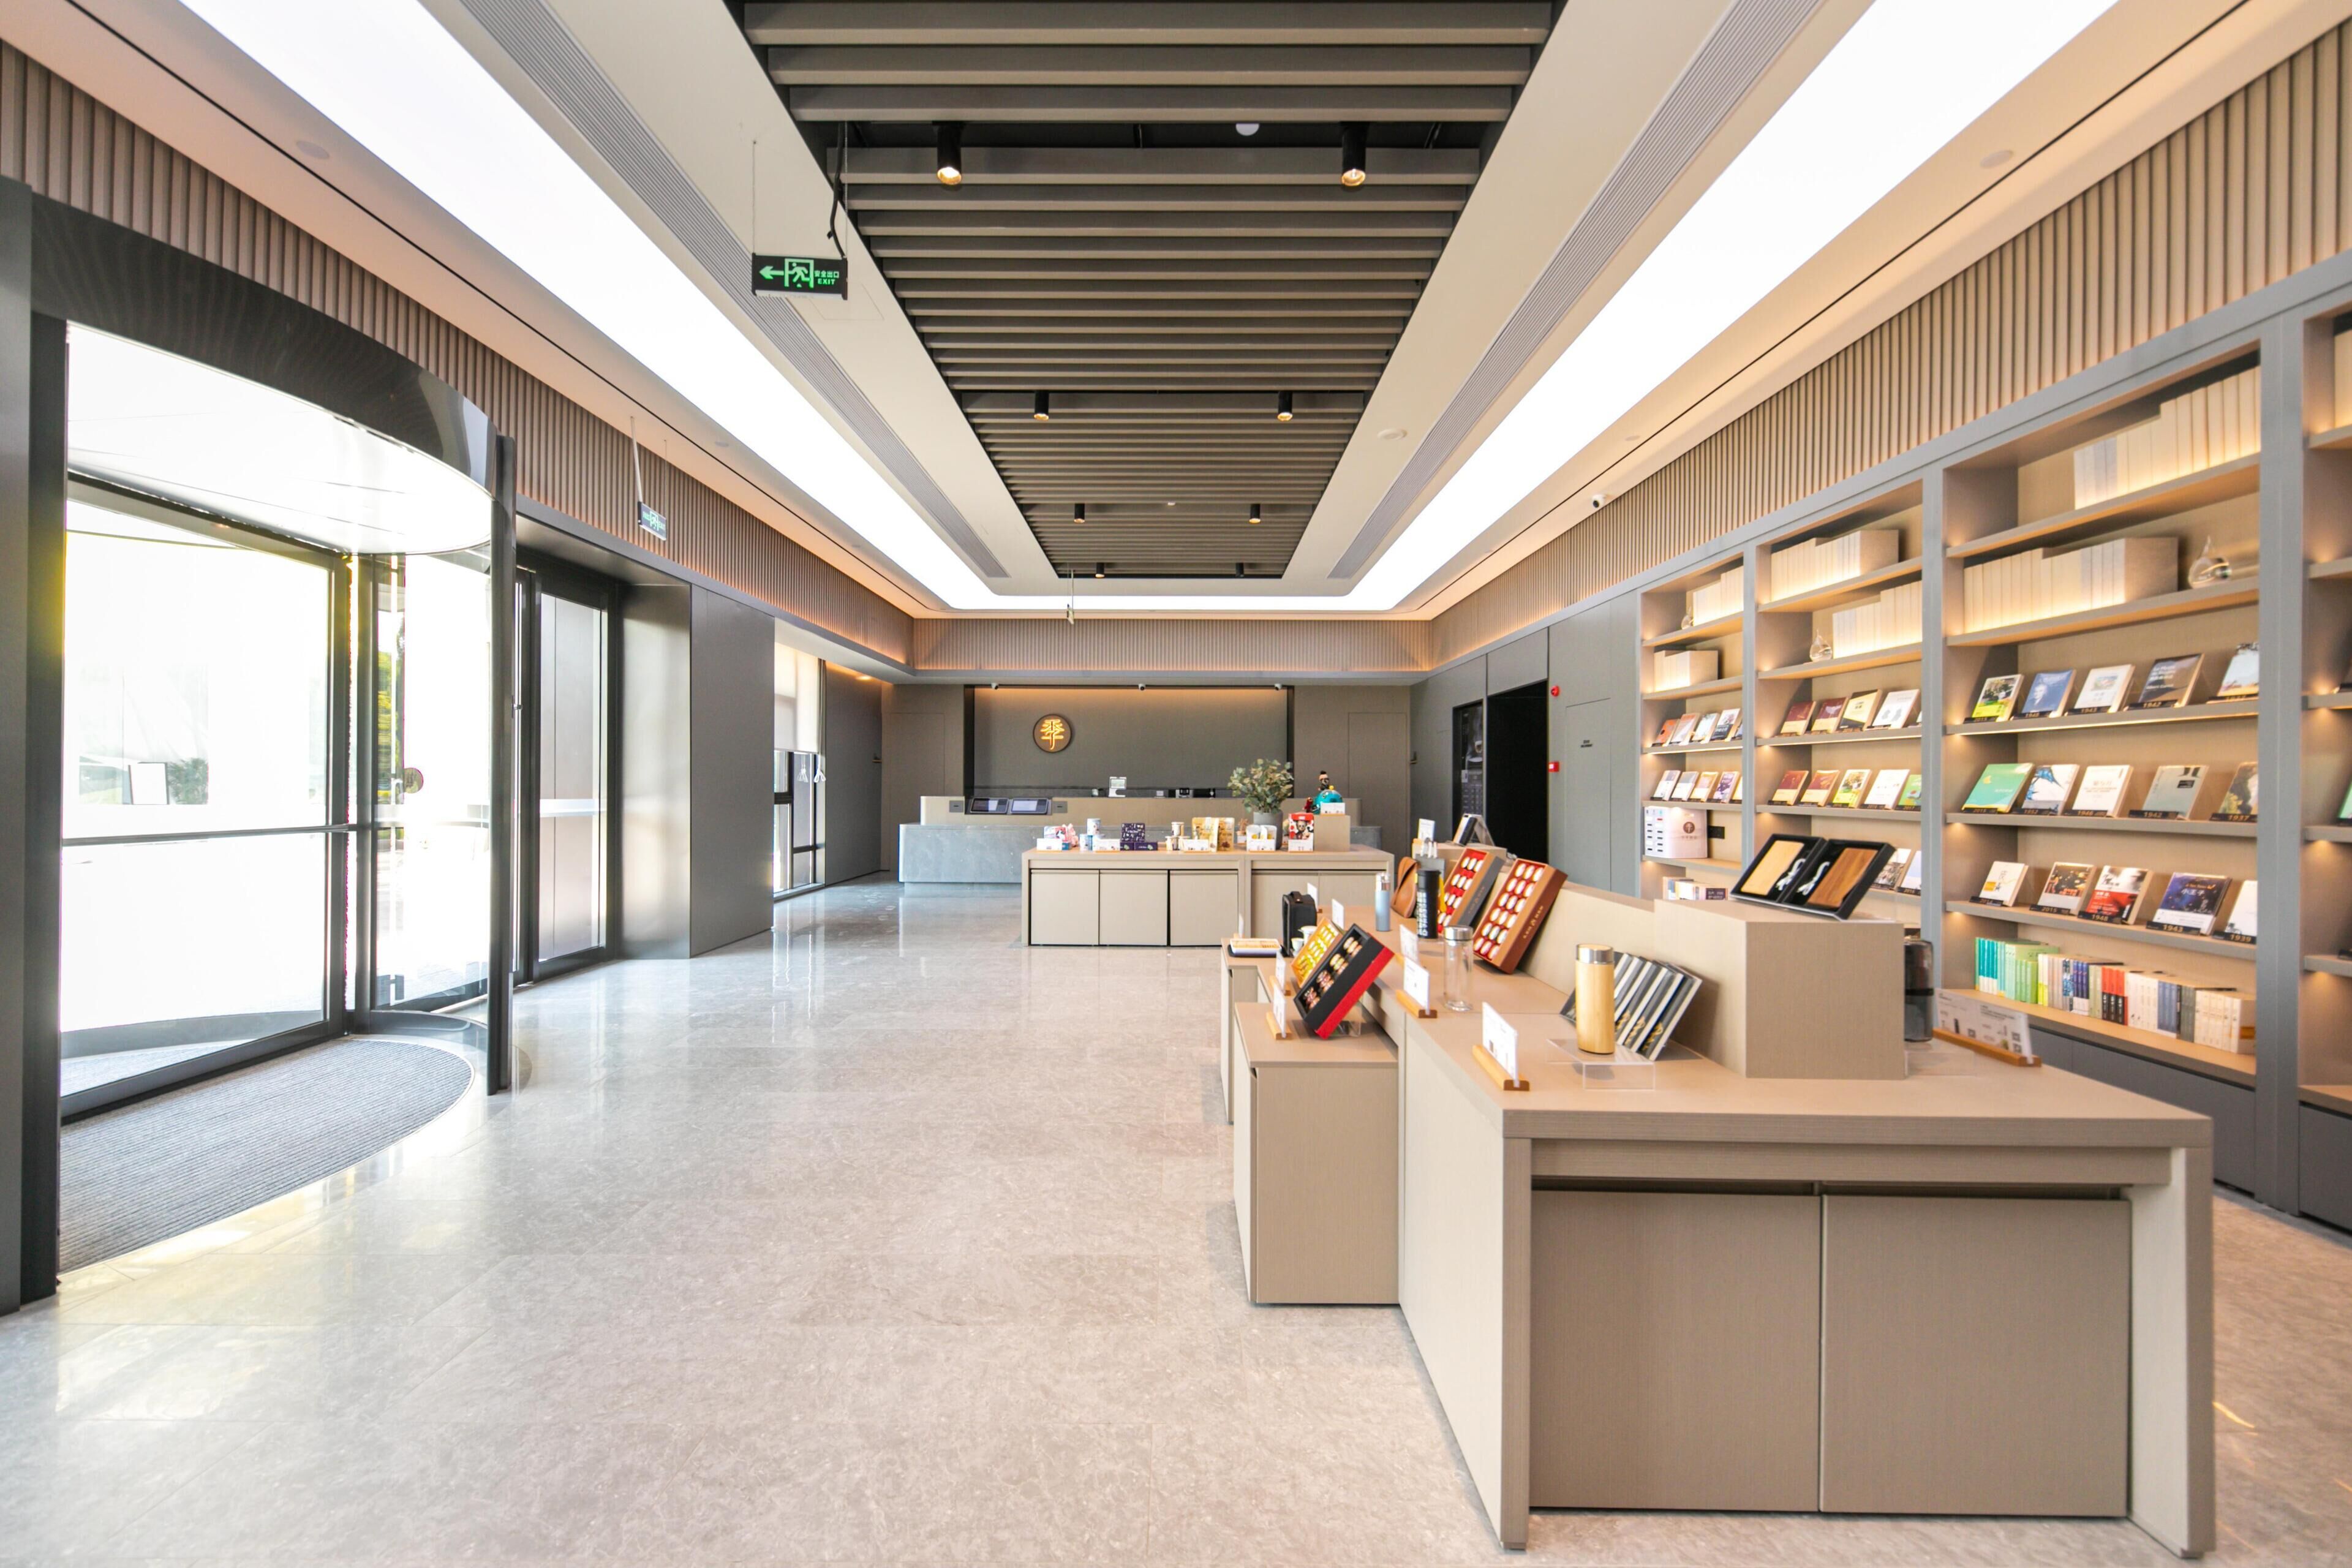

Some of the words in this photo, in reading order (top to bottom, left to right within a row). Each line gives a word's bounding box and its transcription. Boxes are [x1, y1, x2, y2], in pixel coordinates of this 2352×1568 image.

[815, 270, 840, 278] 安全出口
[1040, 718, 1065, 750] 季
[2180, 888, 2206, 897] 小王子
[2163, 924, 2184, 933] 1943
[2230, 933, 2252, 943] 1939
